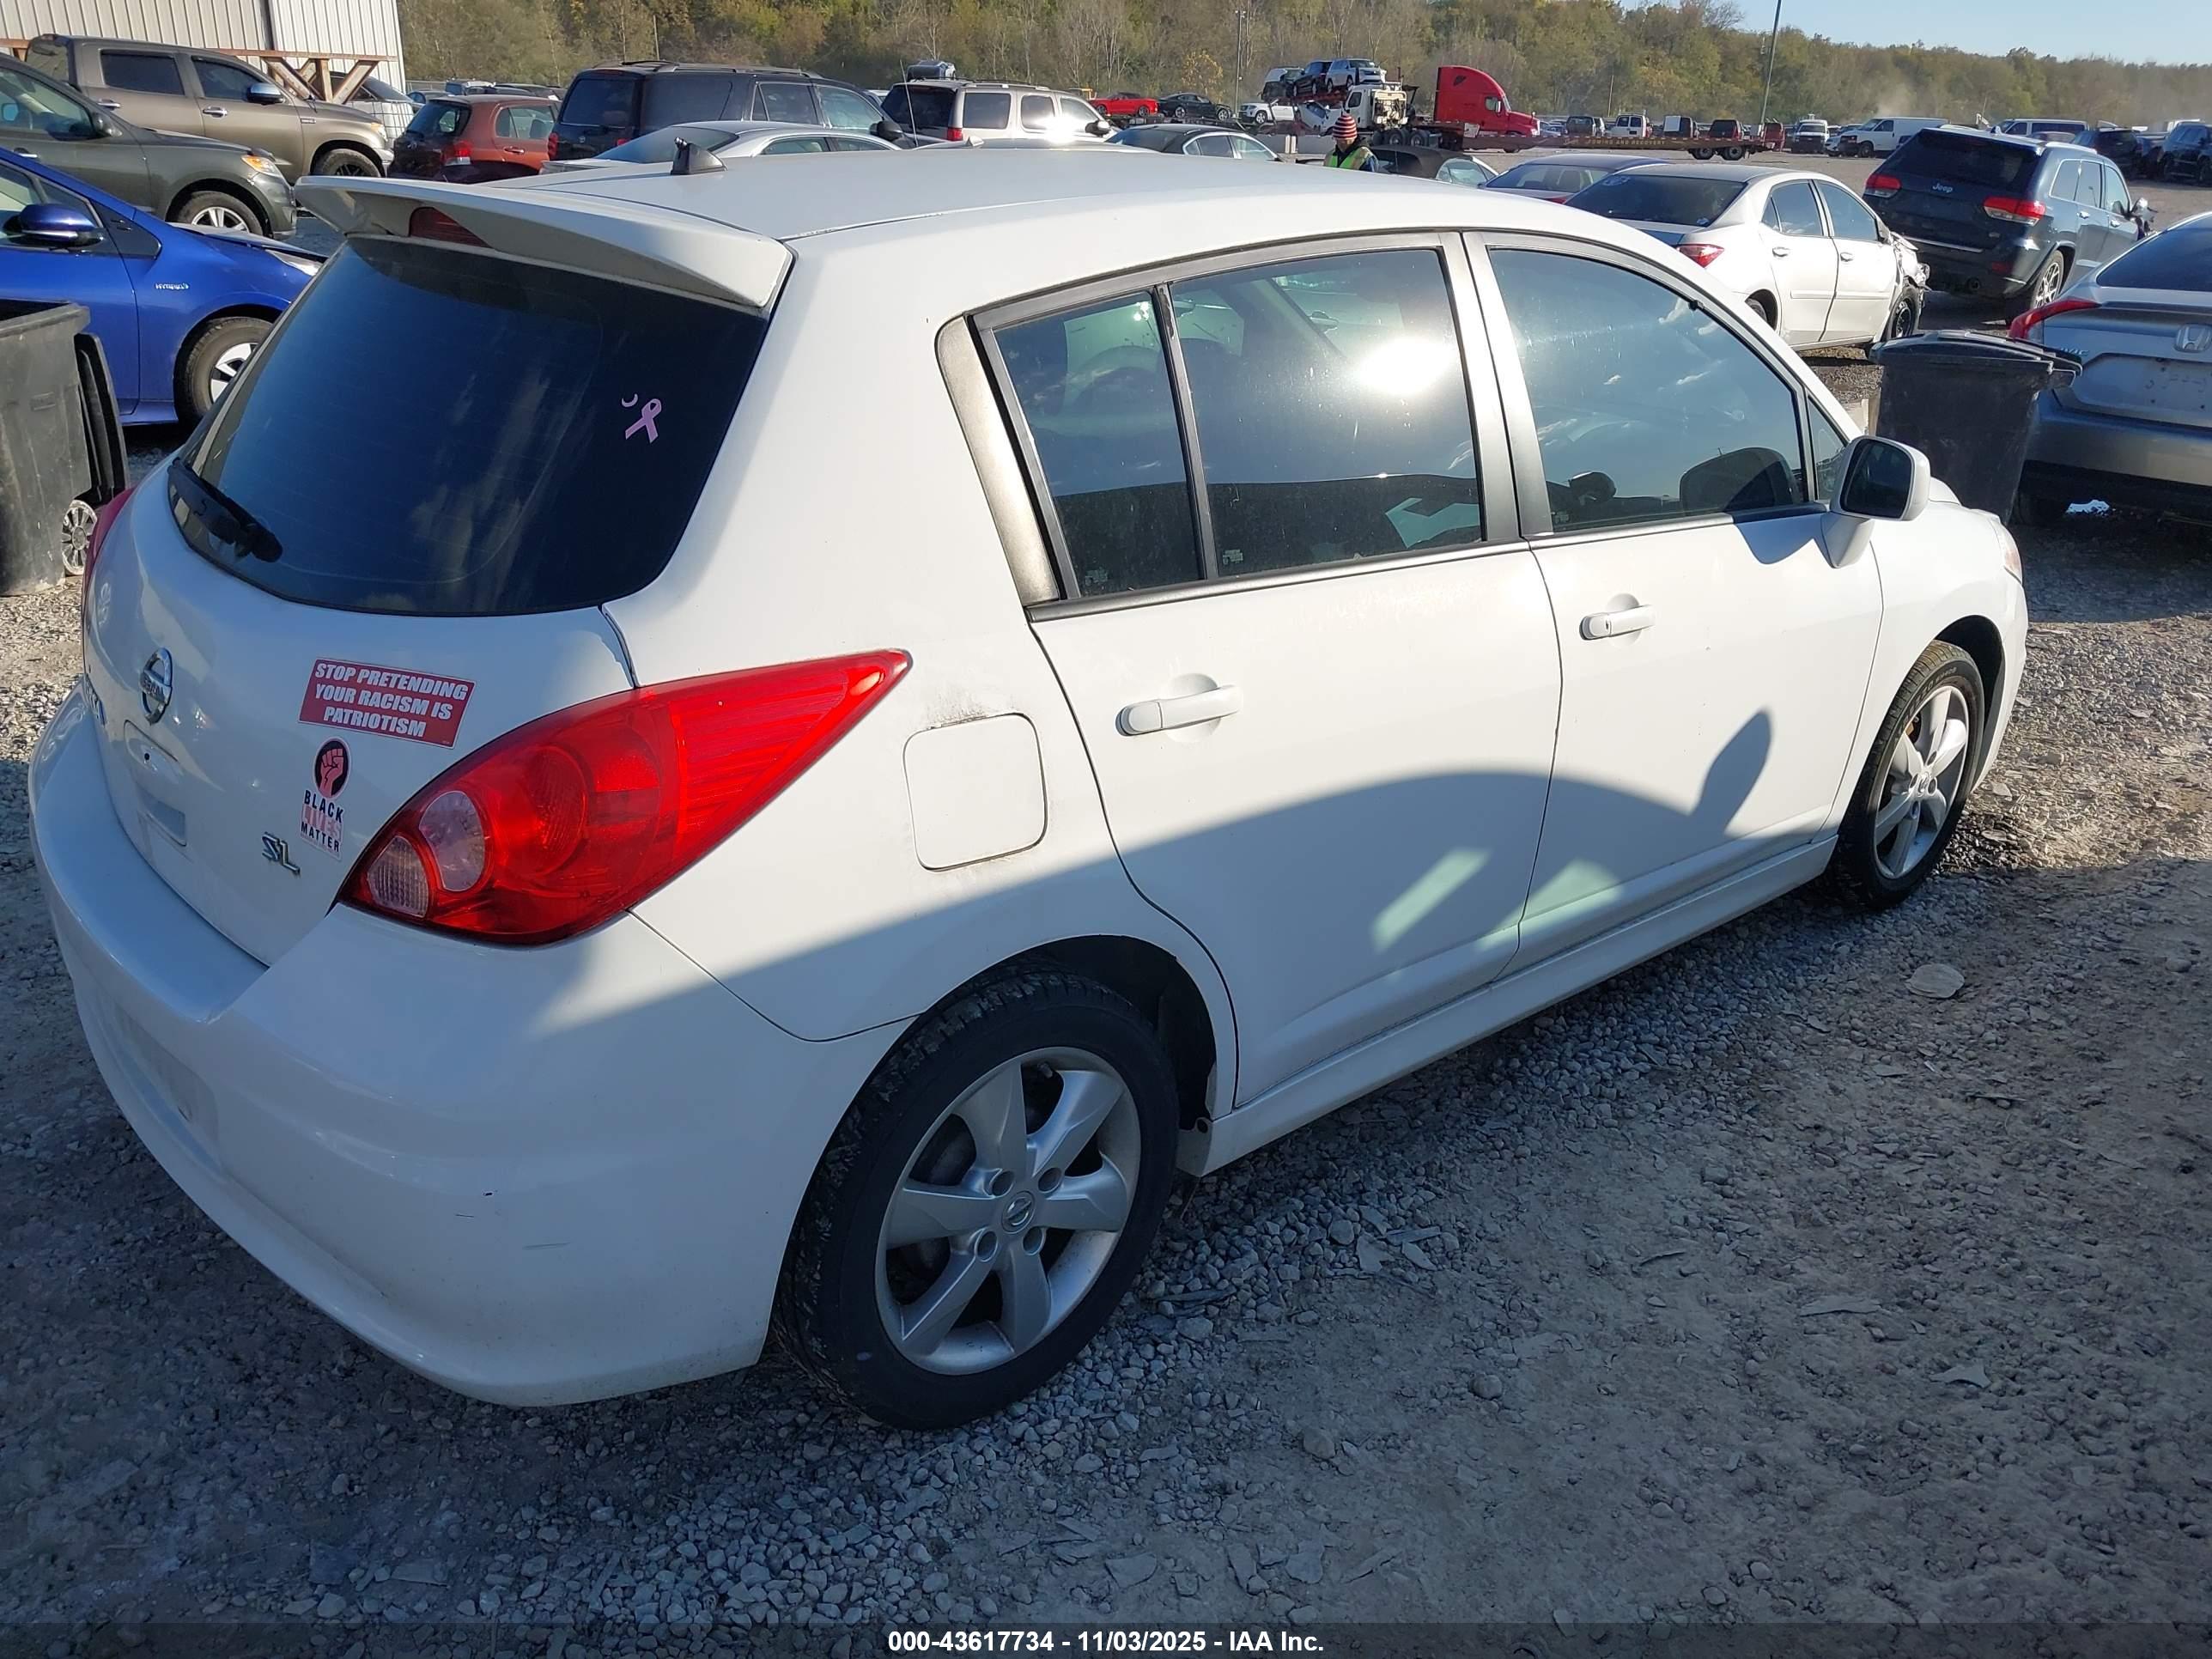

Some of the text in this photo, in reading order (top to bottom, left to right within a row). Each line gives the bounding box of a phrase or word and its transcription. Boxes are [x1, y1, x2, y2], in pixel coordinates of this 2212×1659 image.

[1932, 182, 1954, 193] Jeep
[315, 663, 469, 701] STOP PRETENDING
[315, 684, 453, 720] YOUR RACISM IS
[323, 707, 427, 738] PATRIOTISM
[303, 804, 343, 839] LIVES
[304, 789, 344, 823] BLACK
[261, 831, 301, 876] SL
[301, 821, 340, 853] MATTER
